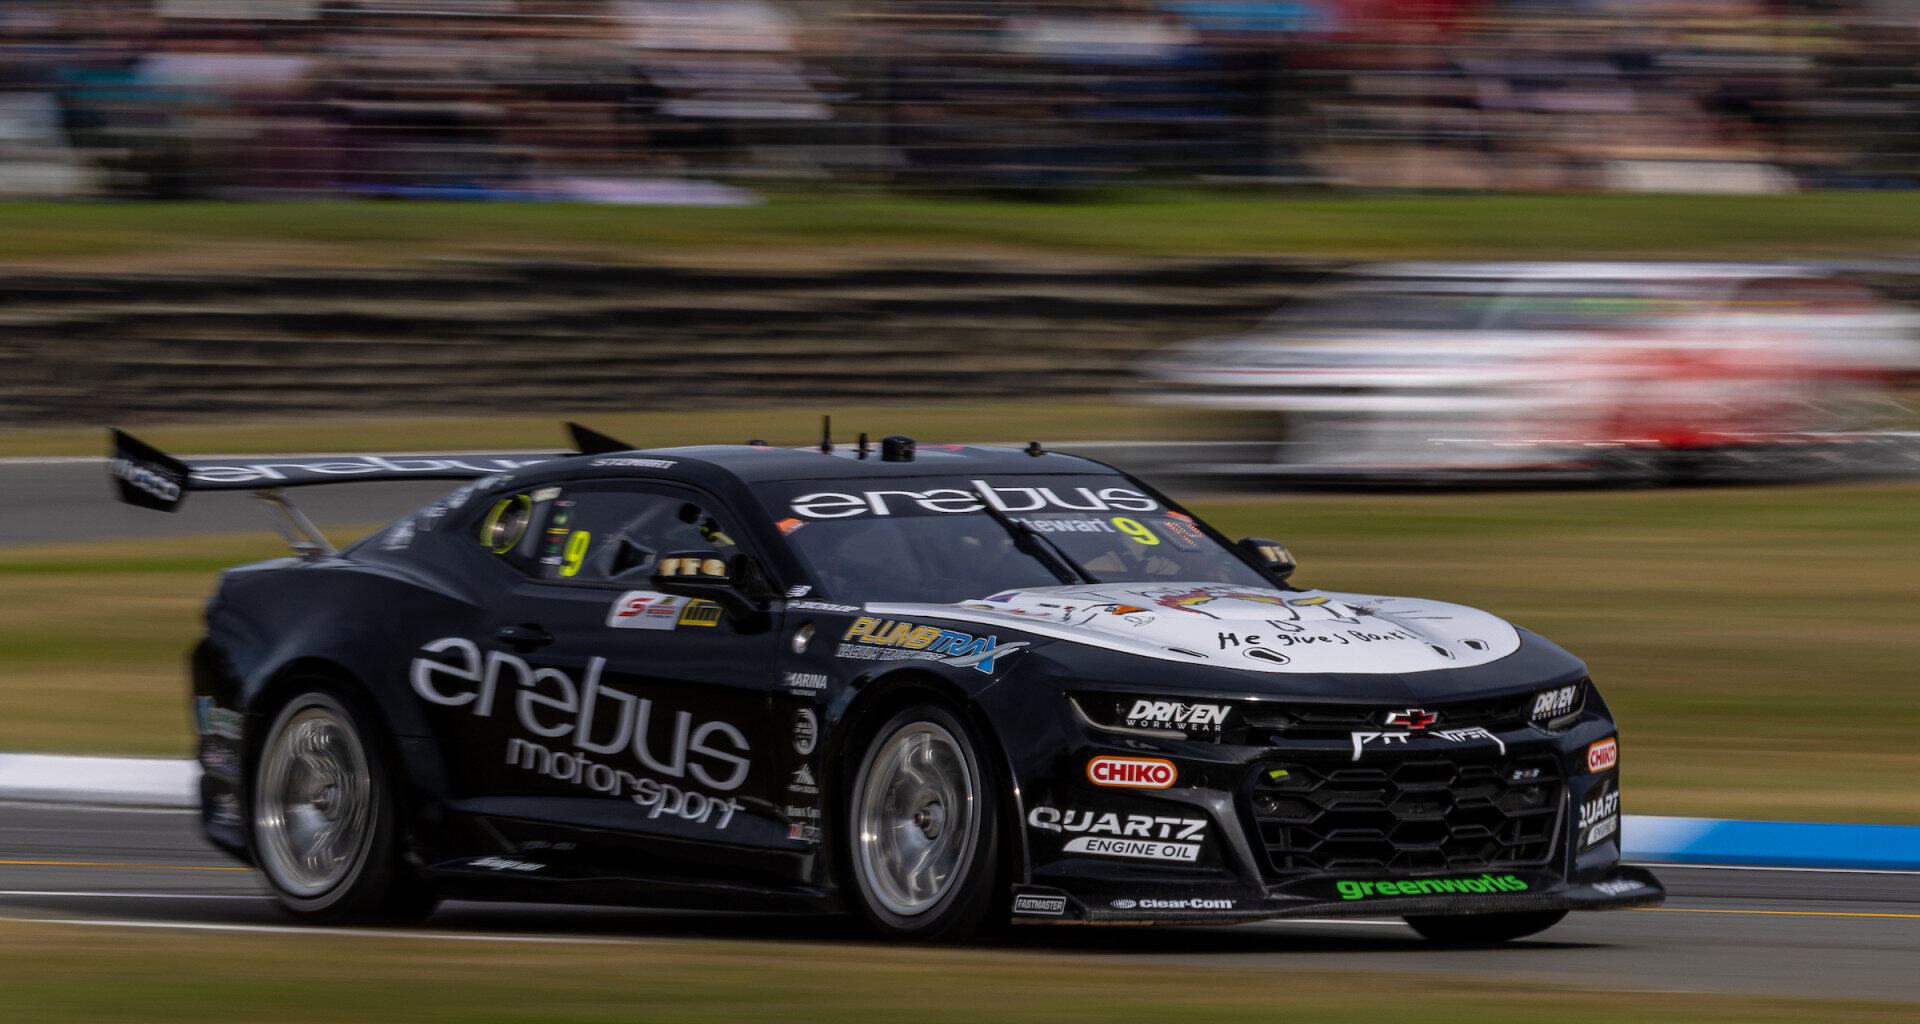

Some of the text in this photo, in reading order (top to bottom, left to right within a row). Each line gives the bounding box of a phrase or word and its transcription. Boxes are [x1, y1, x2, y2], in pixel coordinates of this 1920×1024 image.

[790, 480, 1158, 518] erebus
[1010, 517, 1118, 533] tewart
[1111, 517, 1160, 545] 9
[559, 531, 591, 576] 9
[1218, 632, 1261, 649] He
[409, 637, 750, 791] erebus
[1126, 719, 1222, 732] WORKWEAR
[1127, 700, 1232, 725] DRIVEN
[1590, 746, 1616, 767] CHIKO
[506, 738, 746, 829] motorsport
[1093, 762, 1171, 784] CHIKO
[1028, 806, 1207, 841] QUARTZ
[1086, 839, 1192, 859] ENGINE OIL
[1336, 871, 1528, 900] greenworks
[1017, 897, 1063, 910] FASTMASTER
